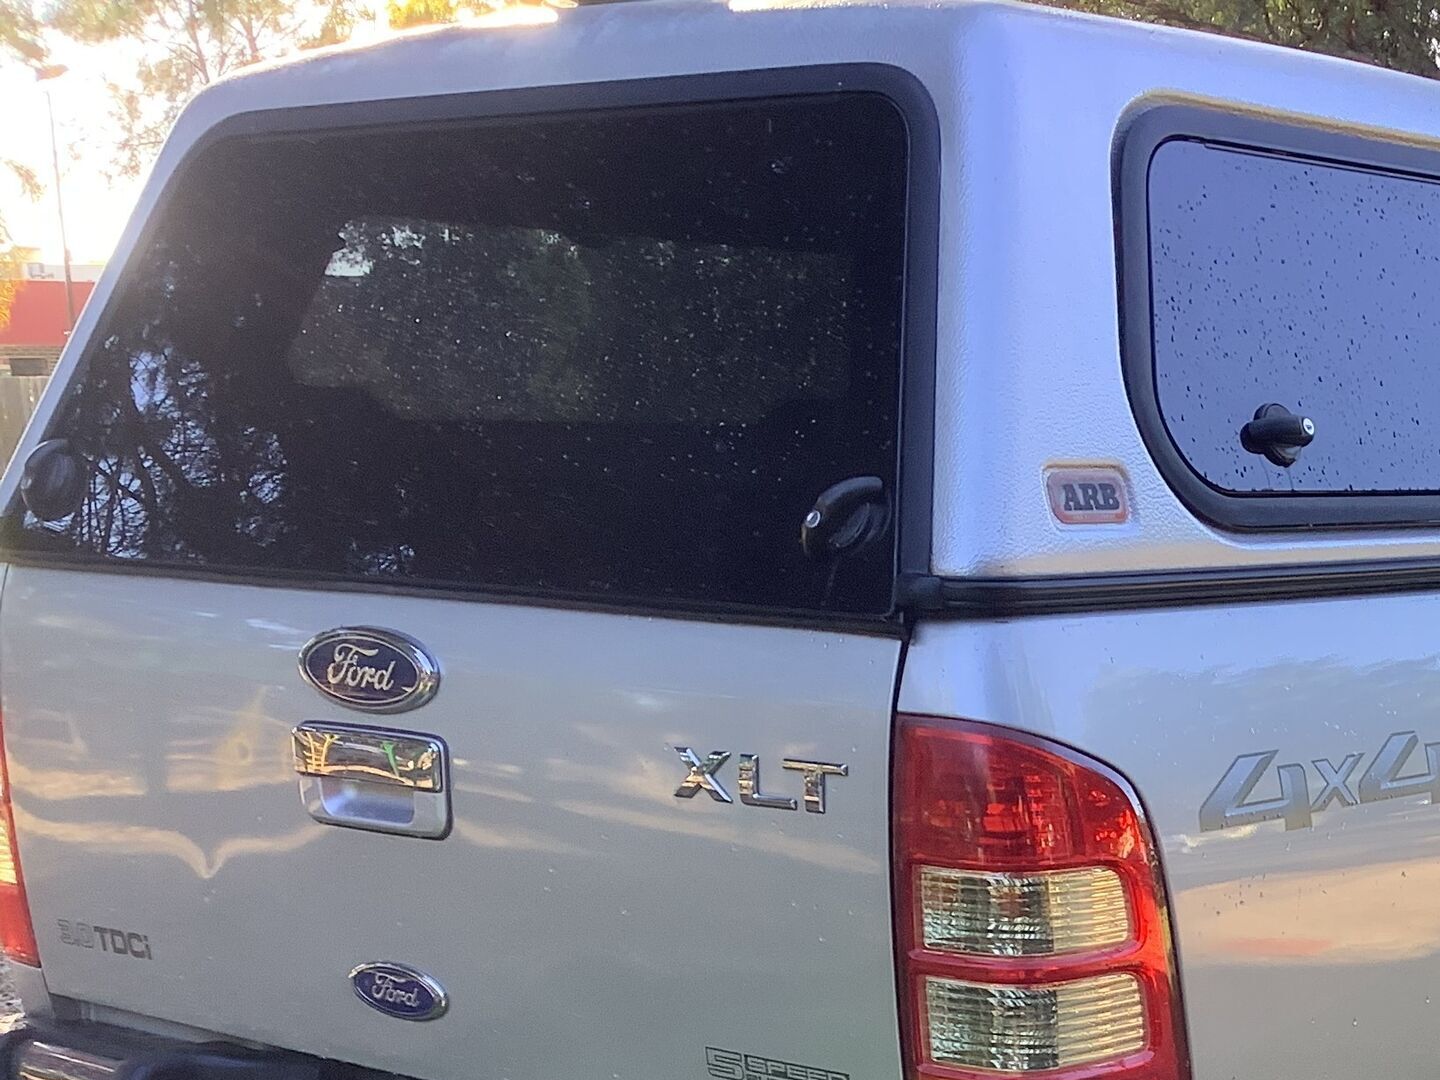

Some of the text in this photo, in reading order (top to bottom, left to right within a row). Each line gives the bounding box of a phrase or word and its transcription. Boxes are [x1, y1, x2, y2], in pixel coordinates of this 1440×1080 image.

[1063, 483, 1120, 511] ARB
[327, 643, 396, 691] Ford
[673, 746, 849, 815] XLT
[371, 971, 420, 1008] Ford
